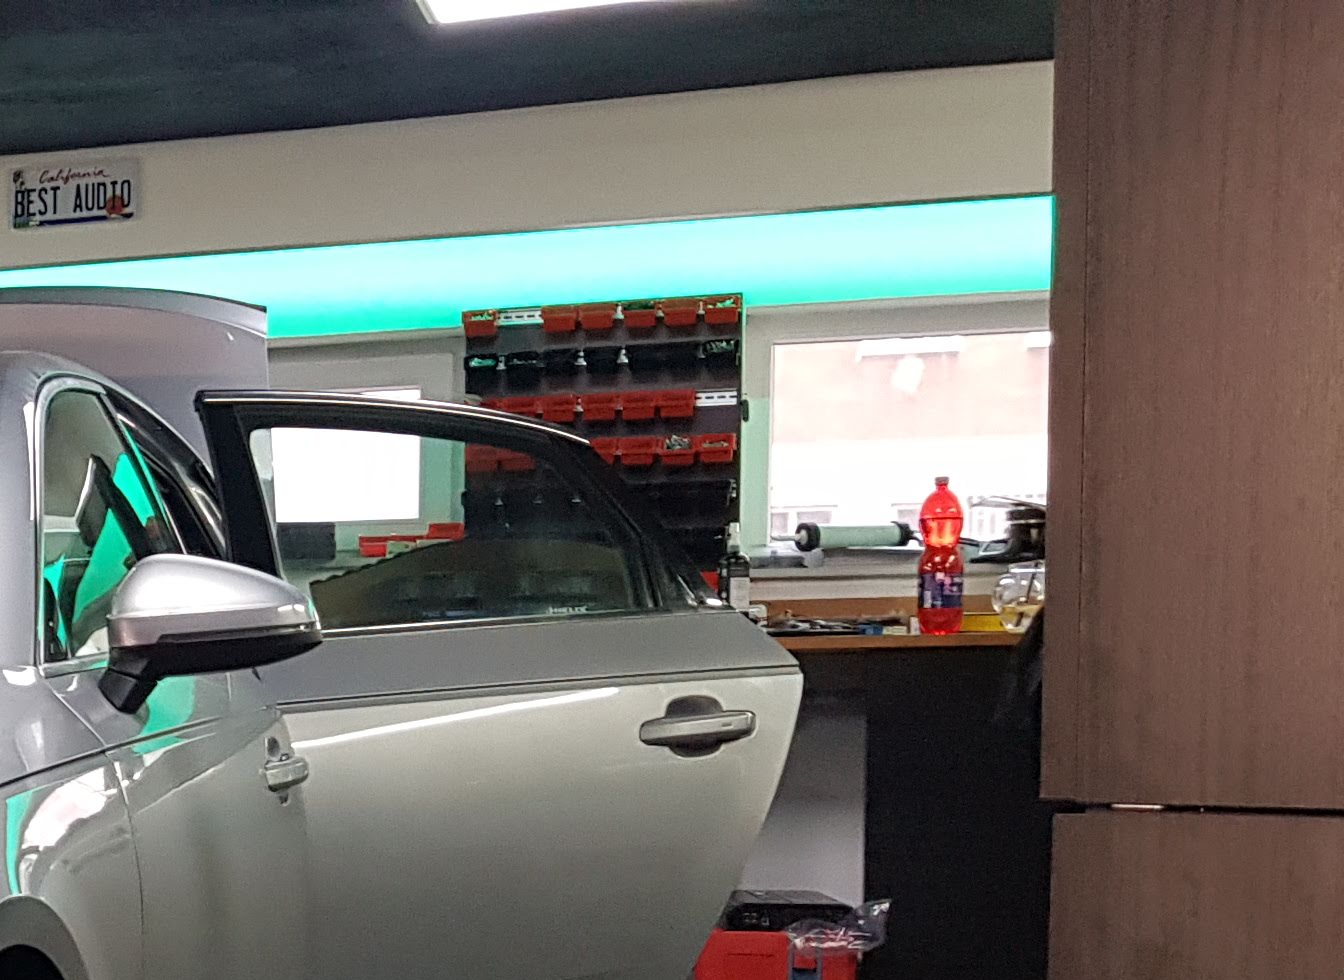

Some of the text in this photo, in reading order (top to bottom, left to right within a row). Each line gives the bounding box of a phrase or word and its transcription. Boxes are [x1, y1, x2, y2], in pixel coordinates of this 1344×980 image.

[39, 168, 110, 185] California
[14, 179, 131, 218] BEST AUDIO
